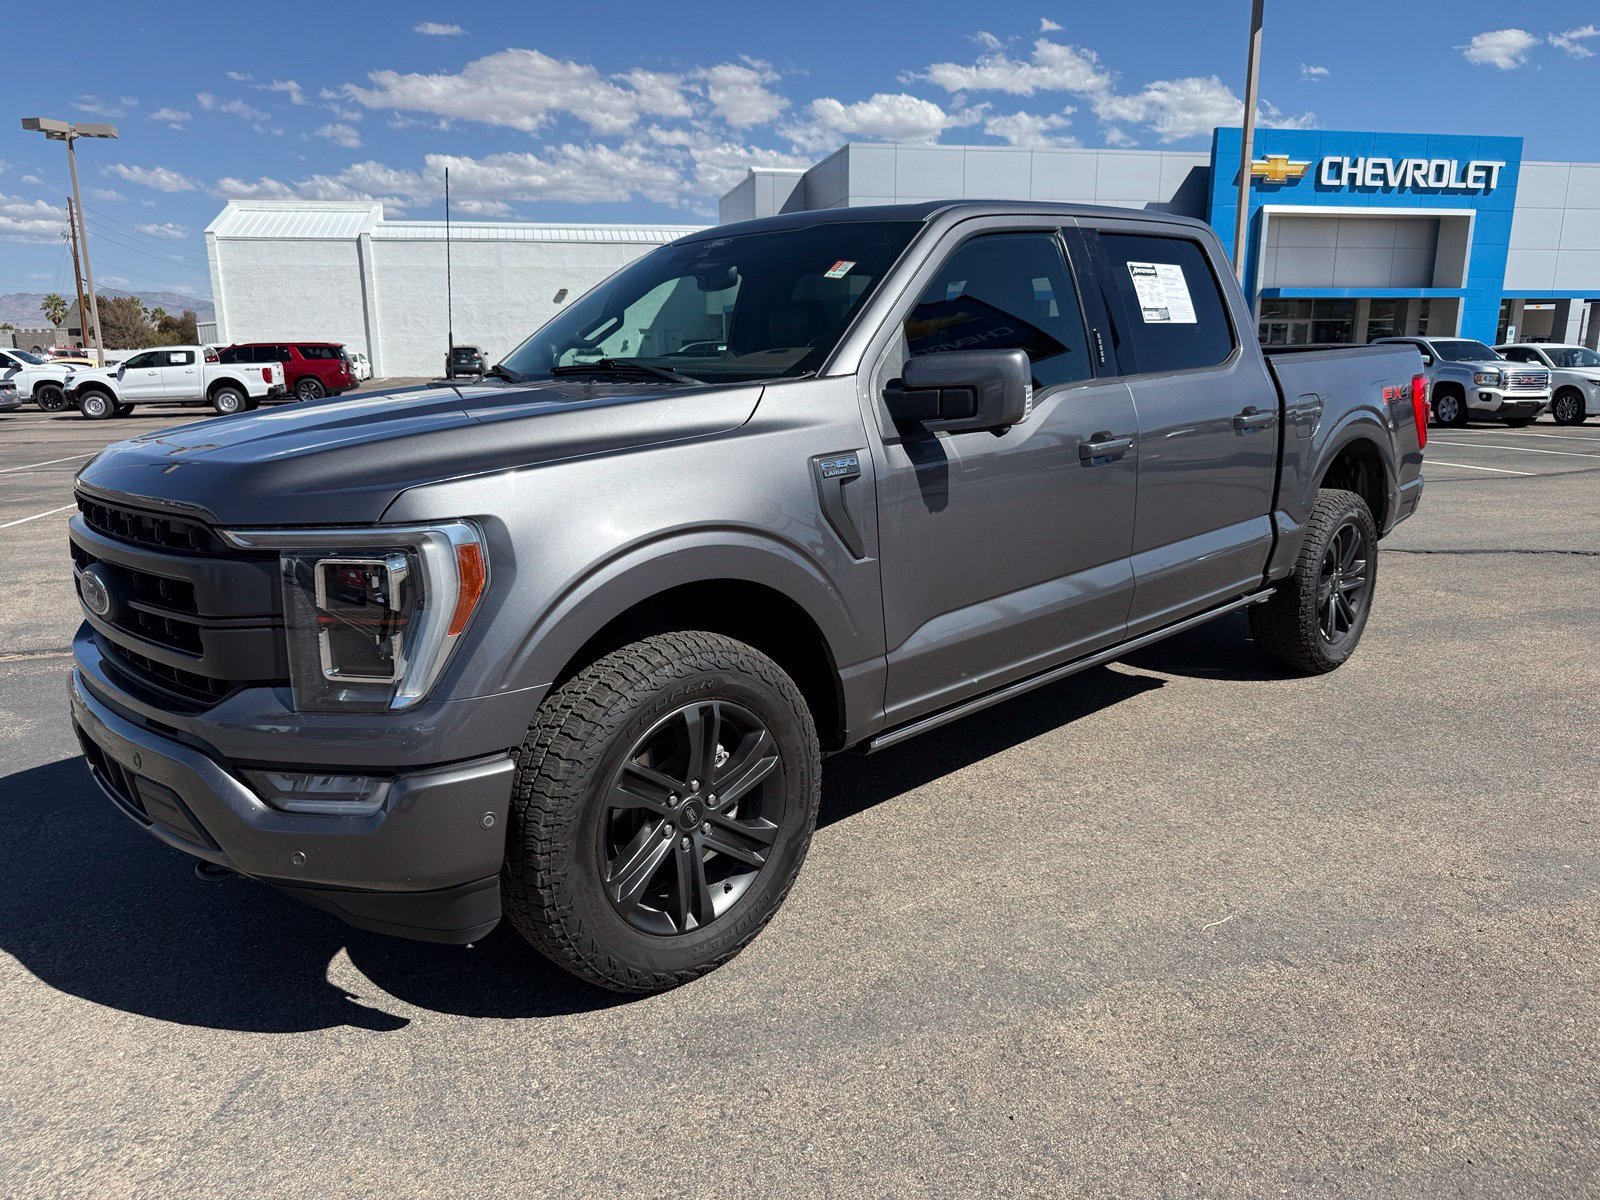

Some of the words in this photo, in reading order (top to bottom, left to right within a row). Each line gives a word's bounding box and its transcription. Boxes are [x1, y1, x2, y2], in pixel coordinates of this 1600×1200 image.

[1321, 156, 1506, 189] CHEVROLET
[1382, 385, 1409, 405] FX4
[821, 457, 858, 470] F-150
[824, 468, 848, 477] LARIAT
[626, 679, 715, 740] COOPER
